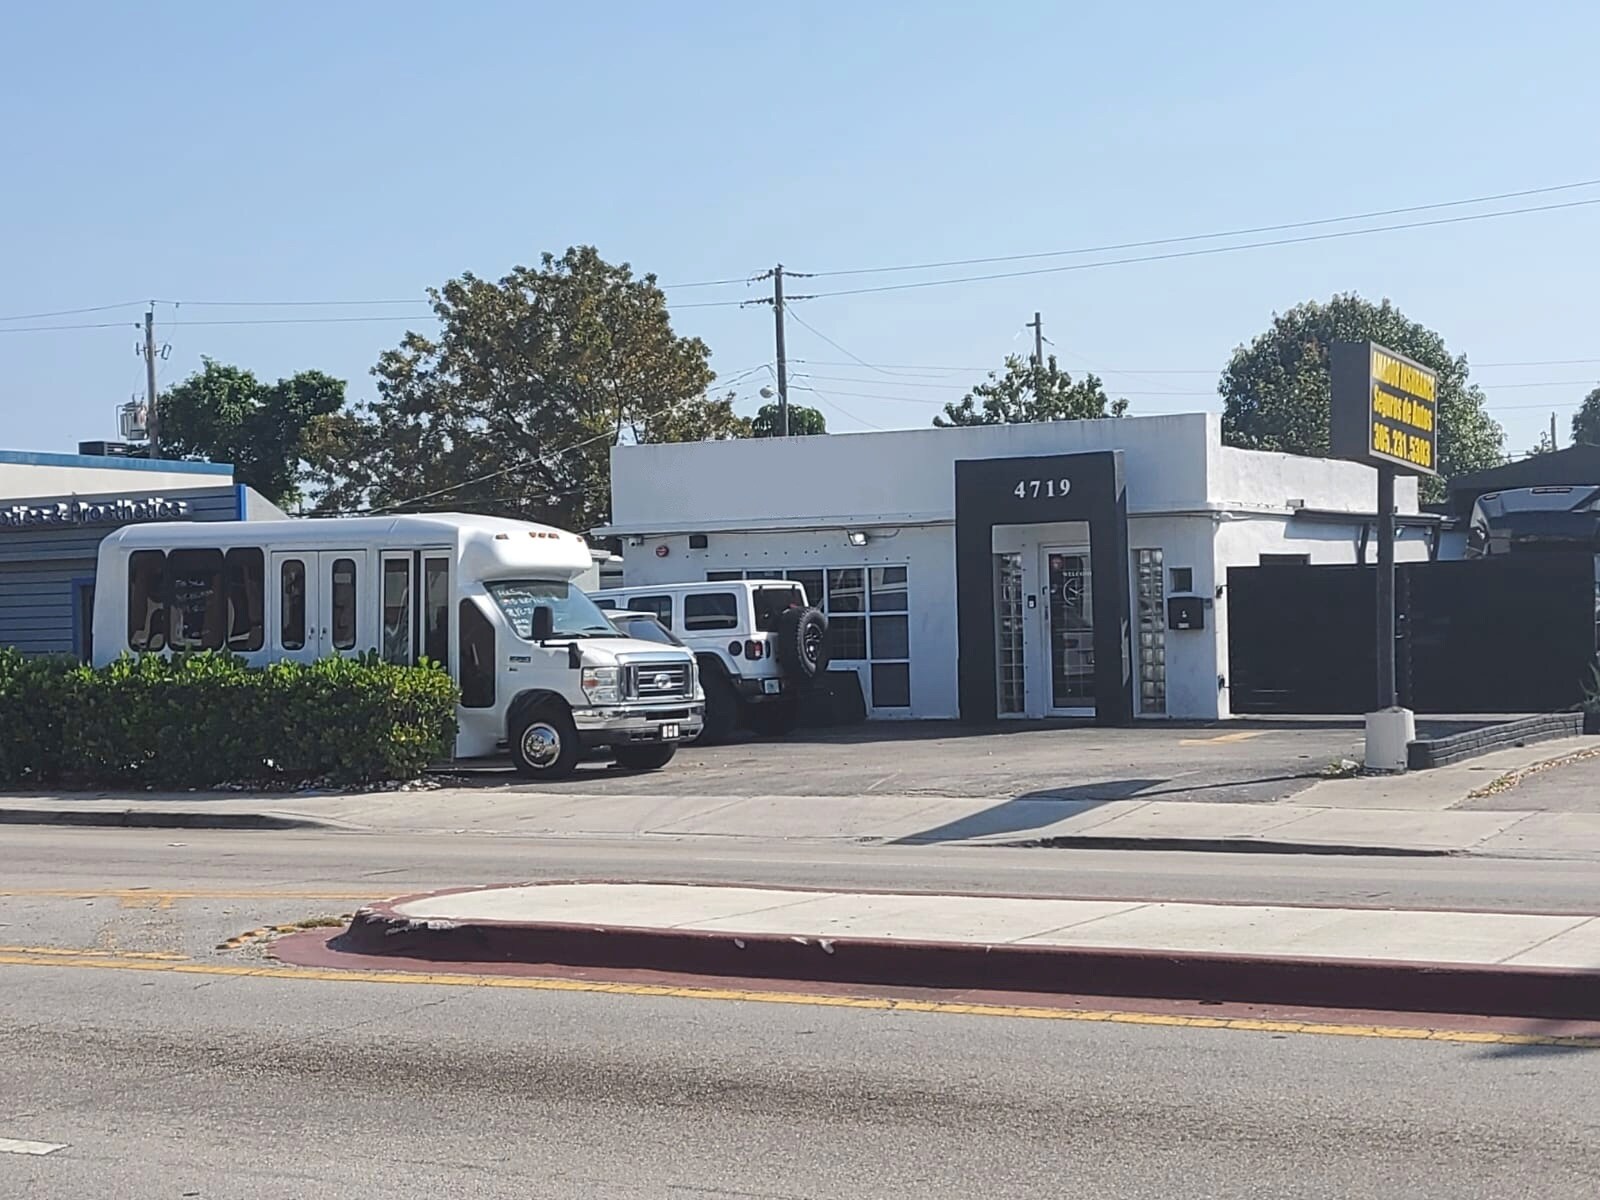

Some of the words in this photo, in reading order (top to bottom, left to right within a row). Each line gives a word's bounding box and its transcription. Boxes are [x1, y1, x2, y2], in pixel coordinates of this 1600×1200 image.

[1374, 384, 1402, 418] Seguros
[1402, 397, 1412, 425] de
[1412, 400, 1432, 432] Autos
[1014, 479, 1071, 498] 4719
[51, 503, 64, 523] &
[71, 498, 185, 522] Prosthetics
